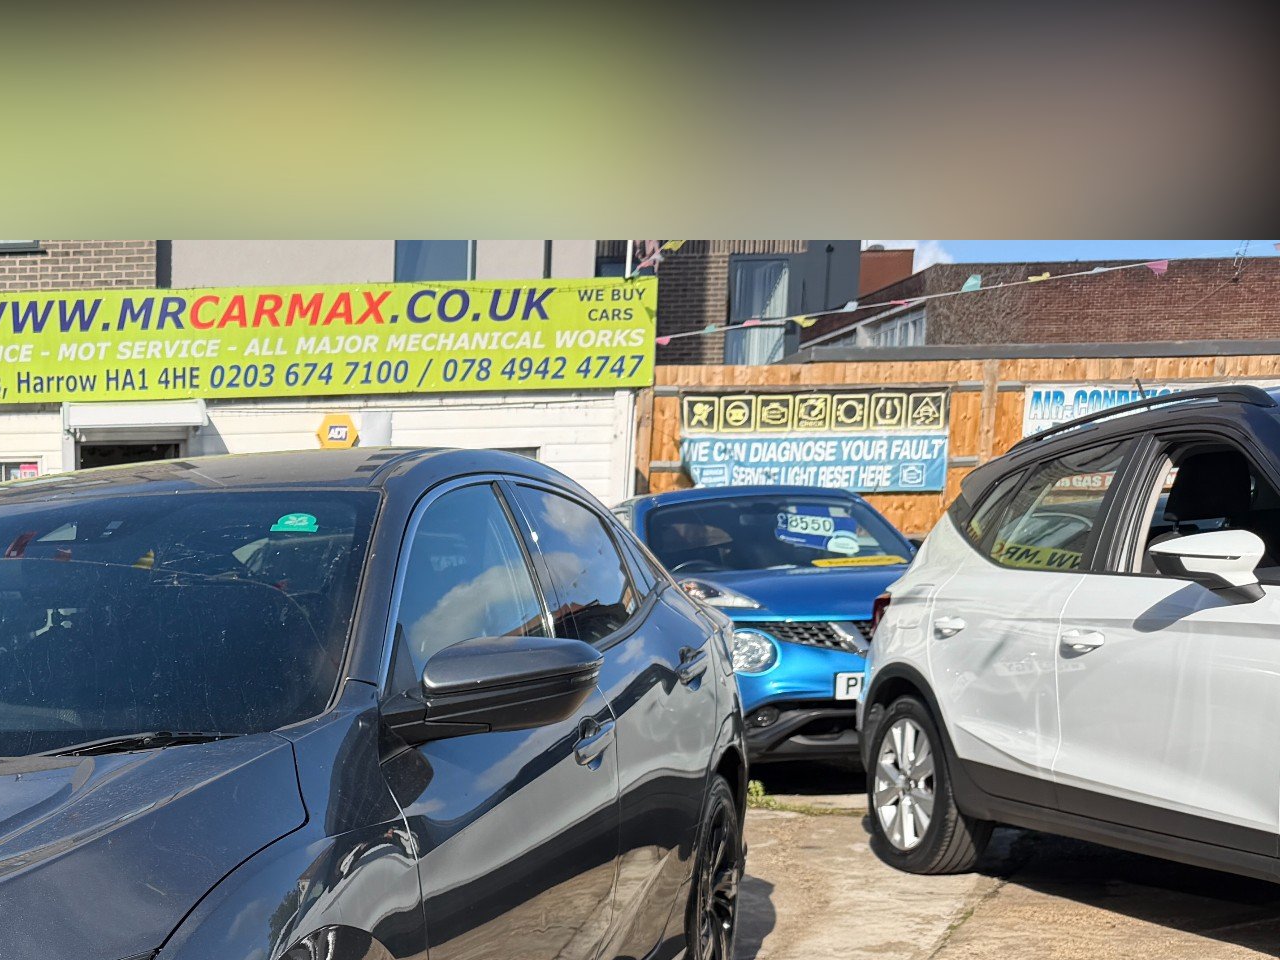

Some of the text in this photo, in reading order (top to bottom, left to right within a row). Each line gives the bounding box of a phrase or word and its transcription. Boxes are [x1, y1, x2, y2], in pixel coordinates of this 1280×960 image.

[578, 287, 645, 302] WE BUY
[588, 308, 634, 322] CARS
[57, 342, 111, 361] MOT
[117, 340, 220, 360] SERVICE
[245, 337, 288, 356] ALL
[295, 335, 379, 355] MAJOR
[386, 330, 545, 352] MECHANICAL
[554, 328, 646, 349] WORKS
[16, 369, 97, 394] Harrow
[106, 368, 148, 392] HA1
[158, 366, 200, 390] 4HE
[210, 363, 274, 389] 0203
[285, 362, 333, 387] 674
[344, 360, 409, 385] 7100
[418, 359, 434, 387] /
[442, 358, 491, 382] 078
[501, 356, 567, 381] 4942
[576, 354, 645, 379] 4747
[328, 426, 348, 441] ADT
[682, 441, 710, 461] WE
[749, 440, 838, 462] DIAGNOSE
[841, 439, 888, 461] YOUR
[890, 438, 945, 460] FAULT
[732, 465, 780, 486] SERVICE
[781, 465, 818, 487] LIGHT
[818, 465, 858, 487] RESET
[858, 465, 894, 487] HERE
[1072, 475, 1102, 487] GAS
